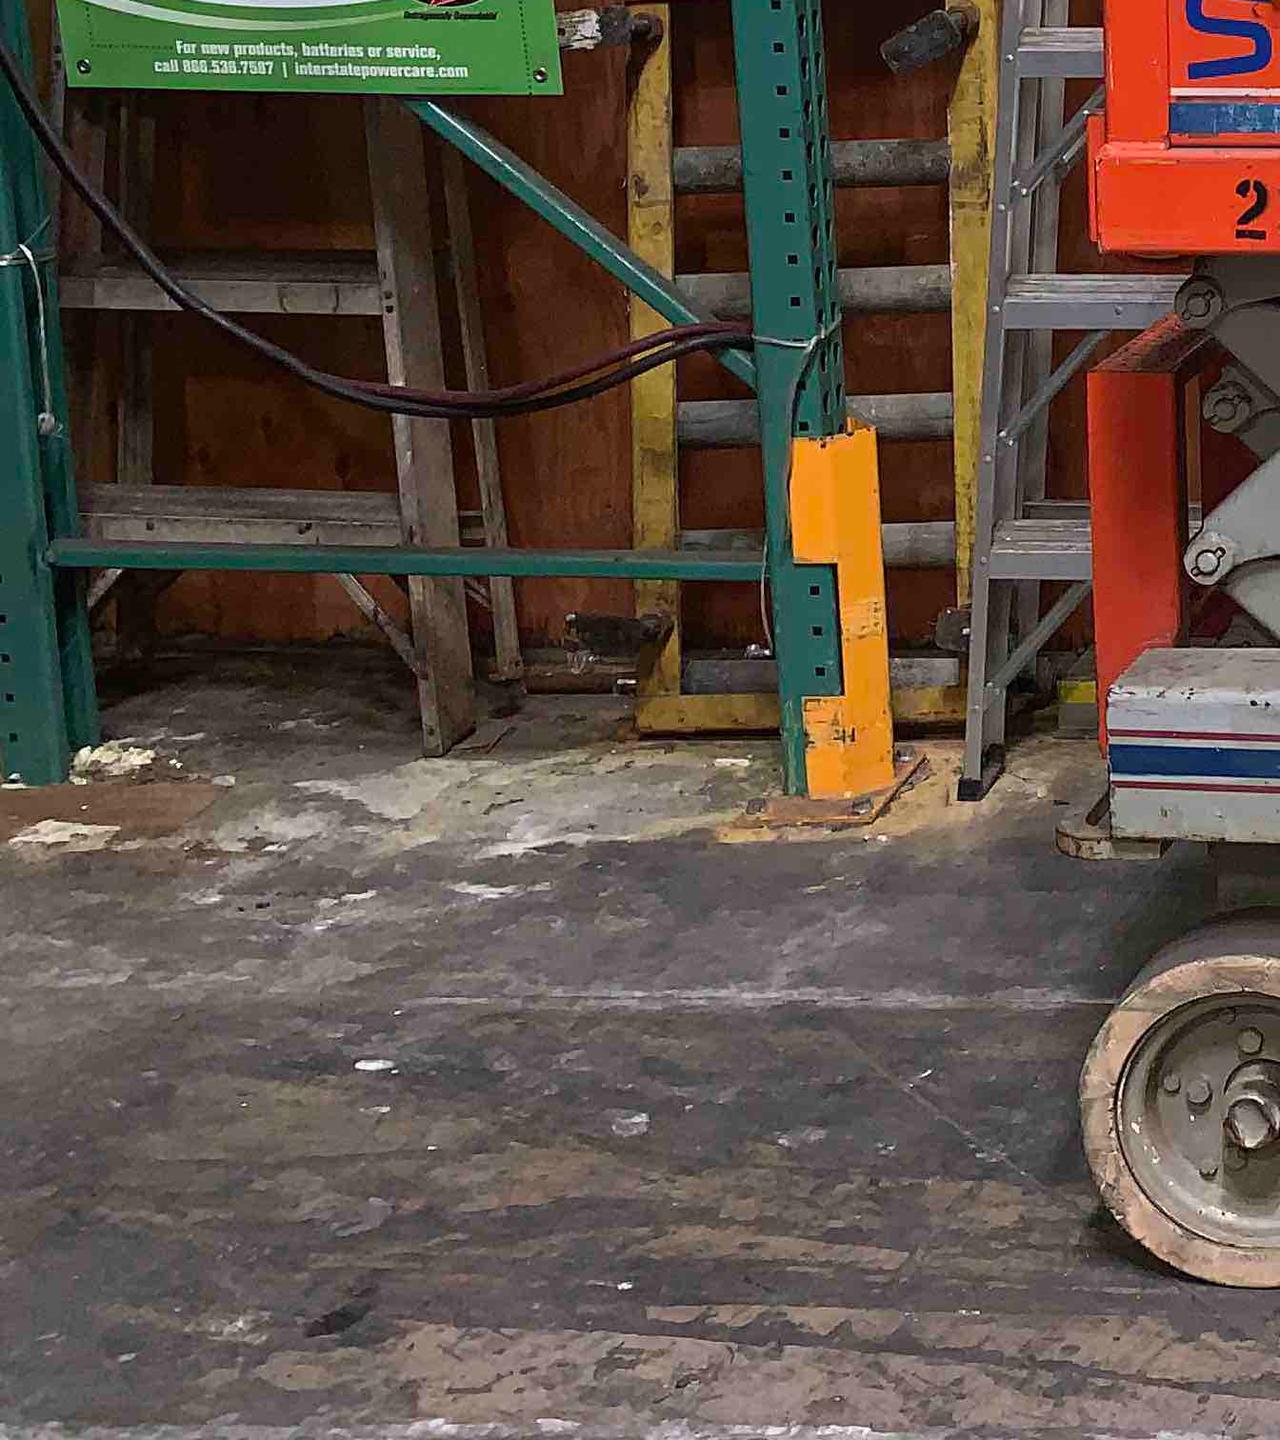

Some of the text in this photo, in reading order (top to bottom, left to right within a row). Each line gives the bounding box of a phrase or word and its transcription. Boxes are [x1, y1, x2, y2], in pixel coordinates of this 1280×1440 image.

[175, 40, 441, 60] For new products, batteries or service,
[154, 59, 179, 73] call
[295, 62, 468, 79] interstatepowercare.com
